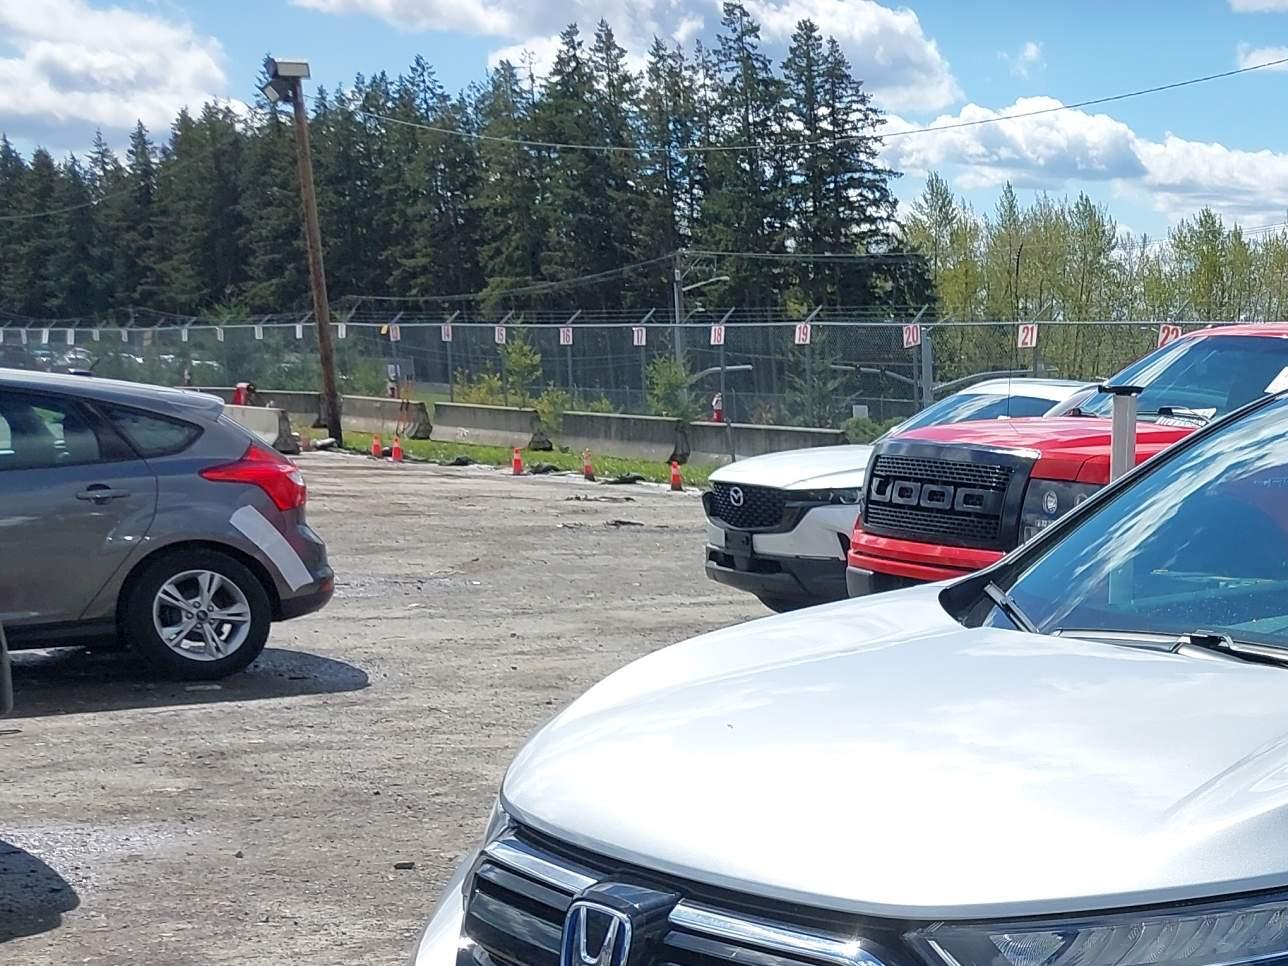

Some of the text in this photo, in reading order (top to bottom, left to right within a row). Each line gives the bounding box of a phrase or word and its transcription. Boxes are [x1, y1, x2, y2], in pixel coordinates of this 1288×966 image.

[562, 328, 572, 343] 16
[636, 329, 645, 344] 17
[713, 327, 724, 343] 18
[798, 325, 809, 342] 19
[905, 325, 919, 346] 20
[1021, 325, 1035, 346] 21
